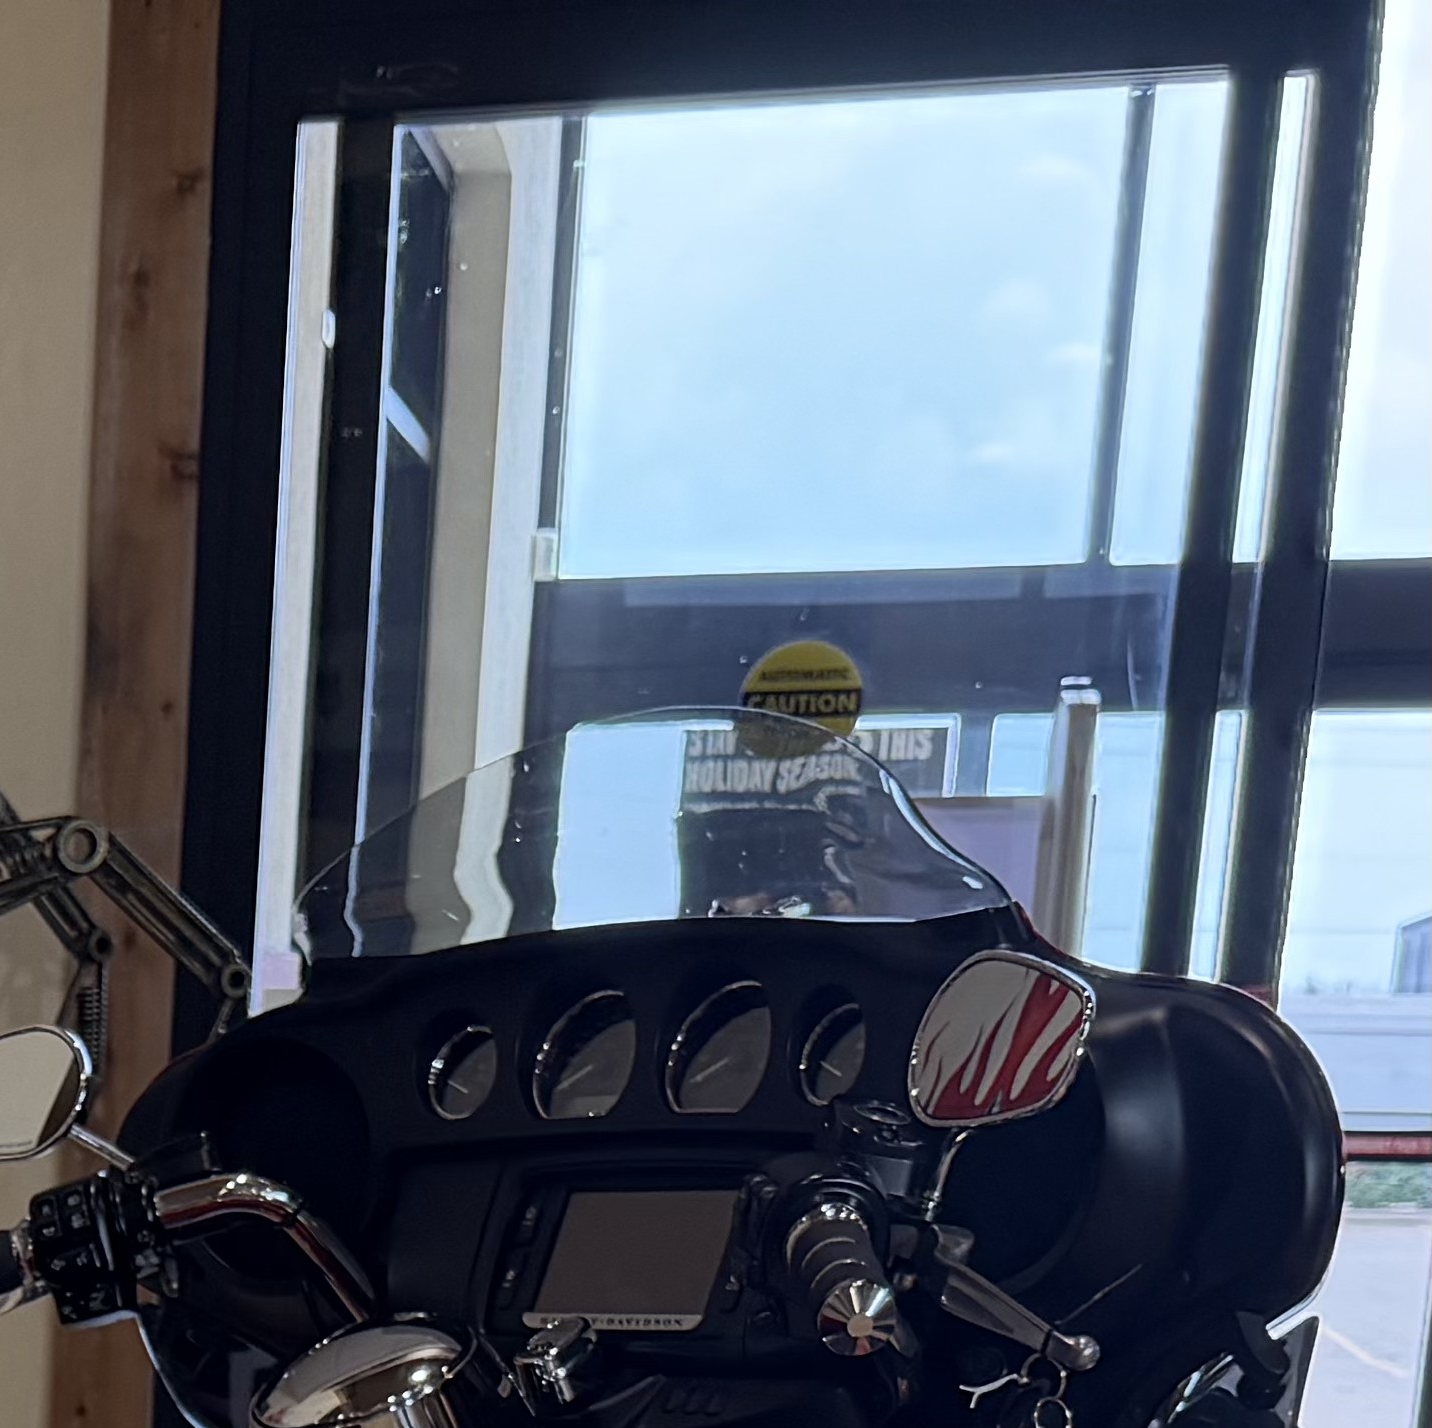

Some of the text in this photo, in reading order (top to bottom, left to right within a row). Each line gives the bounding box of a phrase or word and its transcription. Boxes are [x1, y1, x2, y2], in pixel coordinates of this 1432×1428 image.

[747, 693, 858, 715] CAUTION
[879, 730, 934, 761] THIS
[686, 758, 775, 793] HOLIDAY
